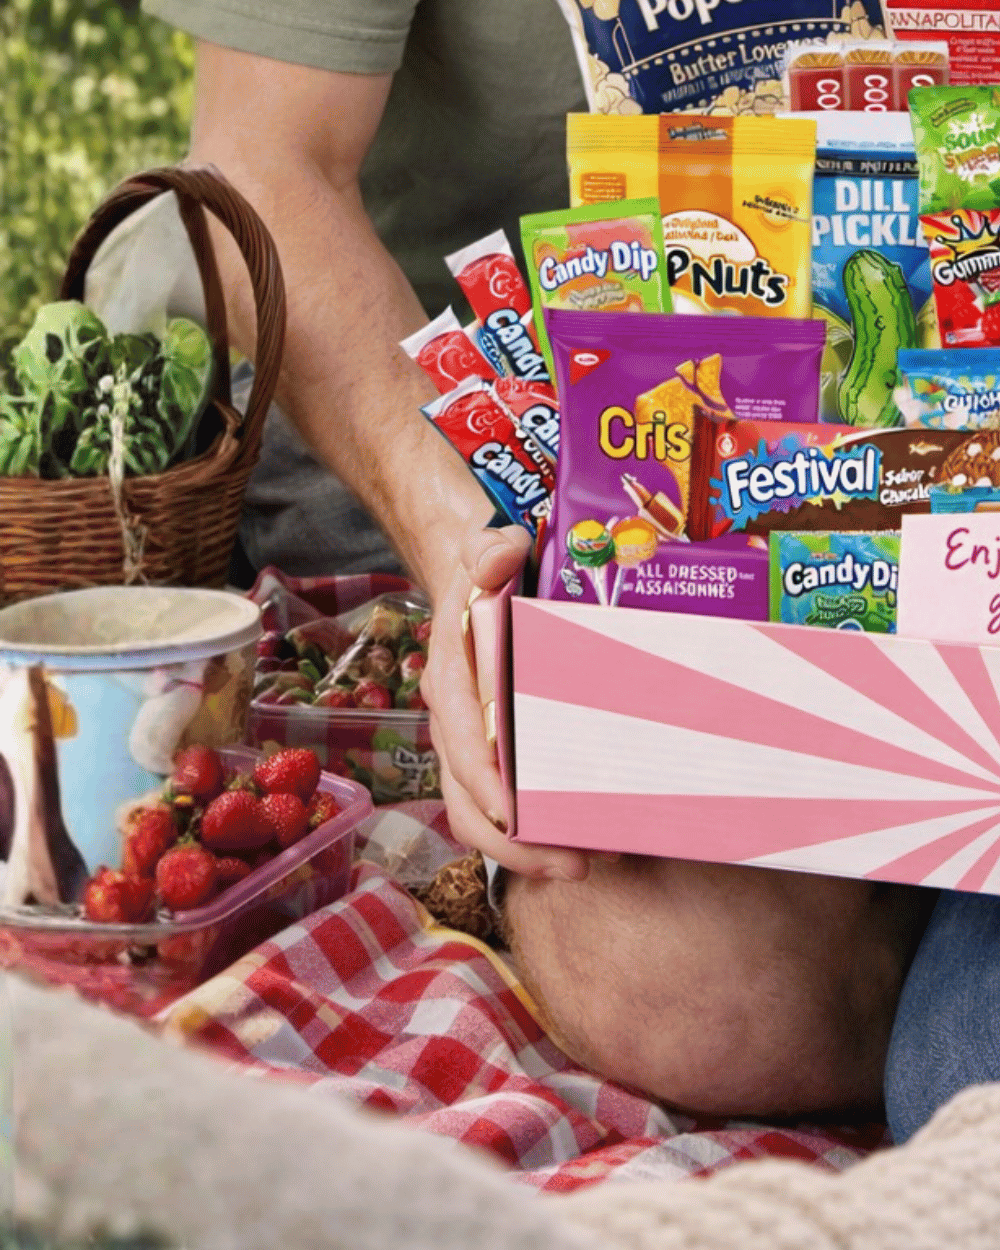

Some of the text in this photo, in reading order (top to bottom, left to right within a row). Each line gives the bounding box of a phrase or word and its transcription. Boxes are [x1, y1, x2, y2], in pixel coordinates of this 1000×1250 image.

[669, 50, 737, 85] Butter
[834, 179, 911, 212] DILL
[539, 240, 658, 290] Candy Dip
[487, 309, 551, 381] Candy
[599, 405, 692, 462] Cris
[472, 442, 547, 504] Candy
[726, 446, 876, 511] Festival
[636, 563, 664, 578] ALL
[669, 564, 738, 583] DRESSED
[785, 554, 870, 595] Candy
